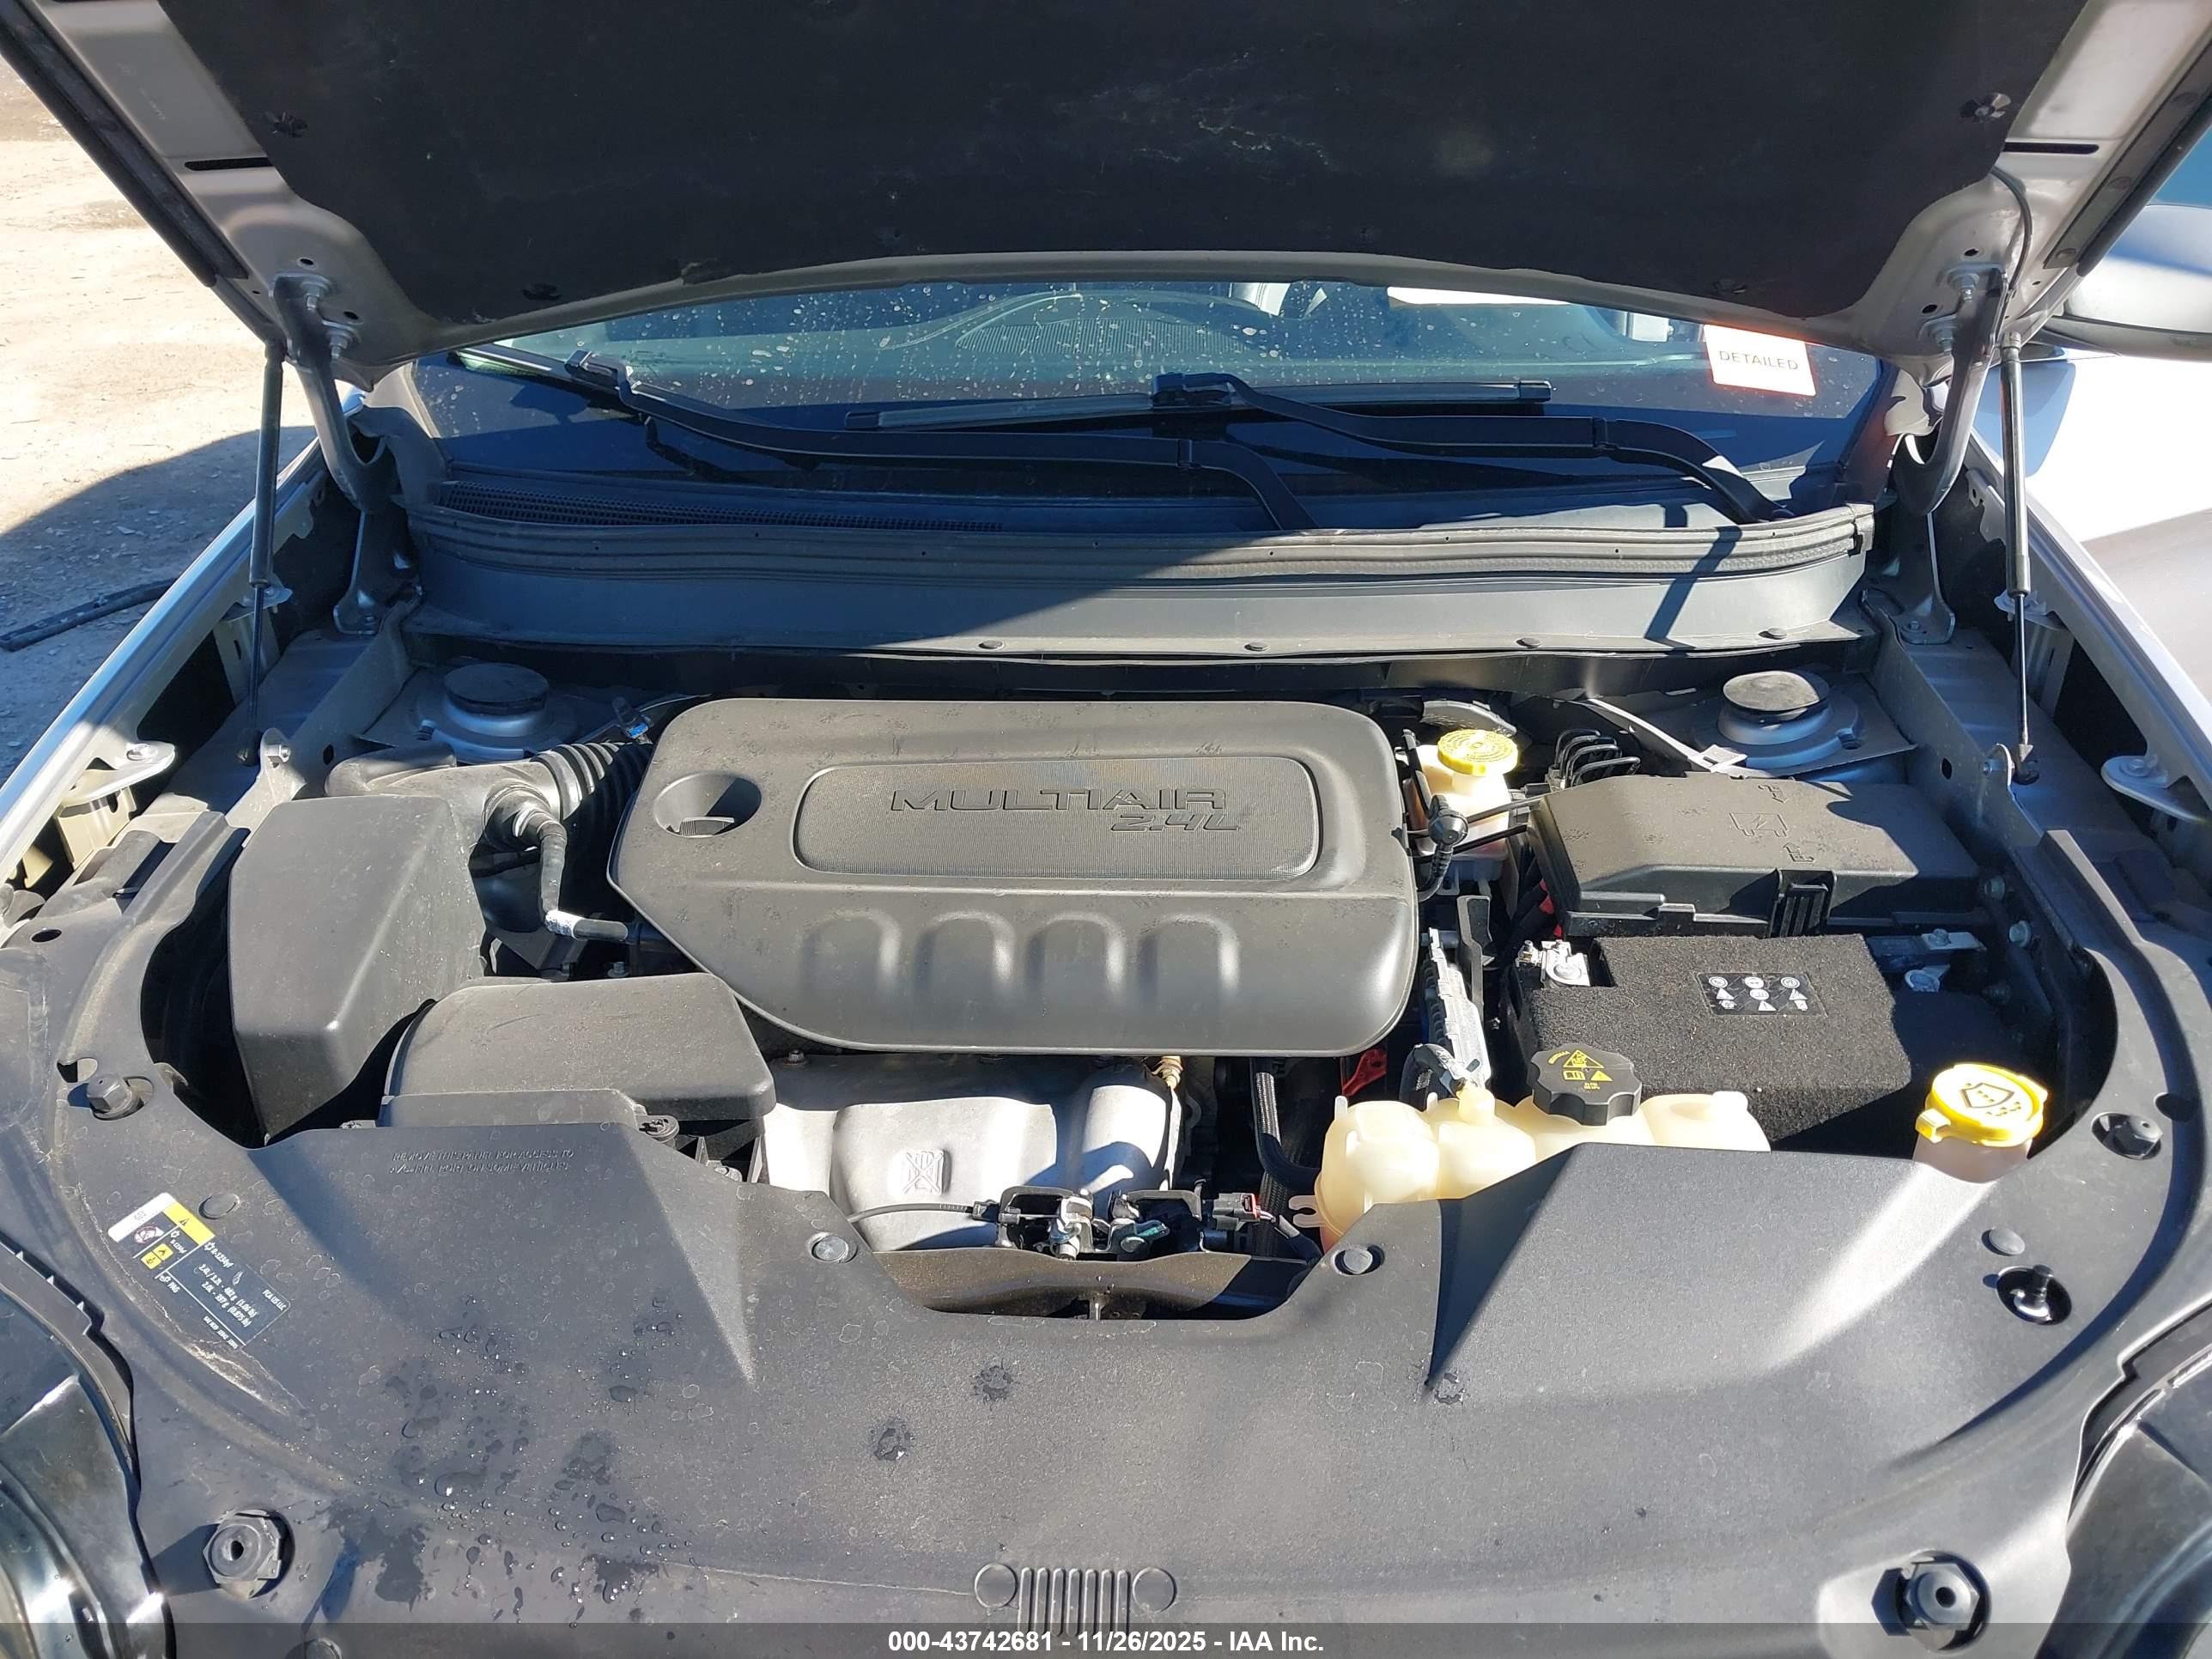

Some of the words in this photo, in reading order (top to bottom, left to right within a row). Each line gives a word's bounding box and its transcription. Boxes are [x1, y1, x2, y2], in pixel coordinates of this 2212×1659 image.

[1719, 350, 1799, 371] DETAILED
[890, 788, 1227, 811] MULTIAIR
[1110, 812, 1241, 832] 2.4L
